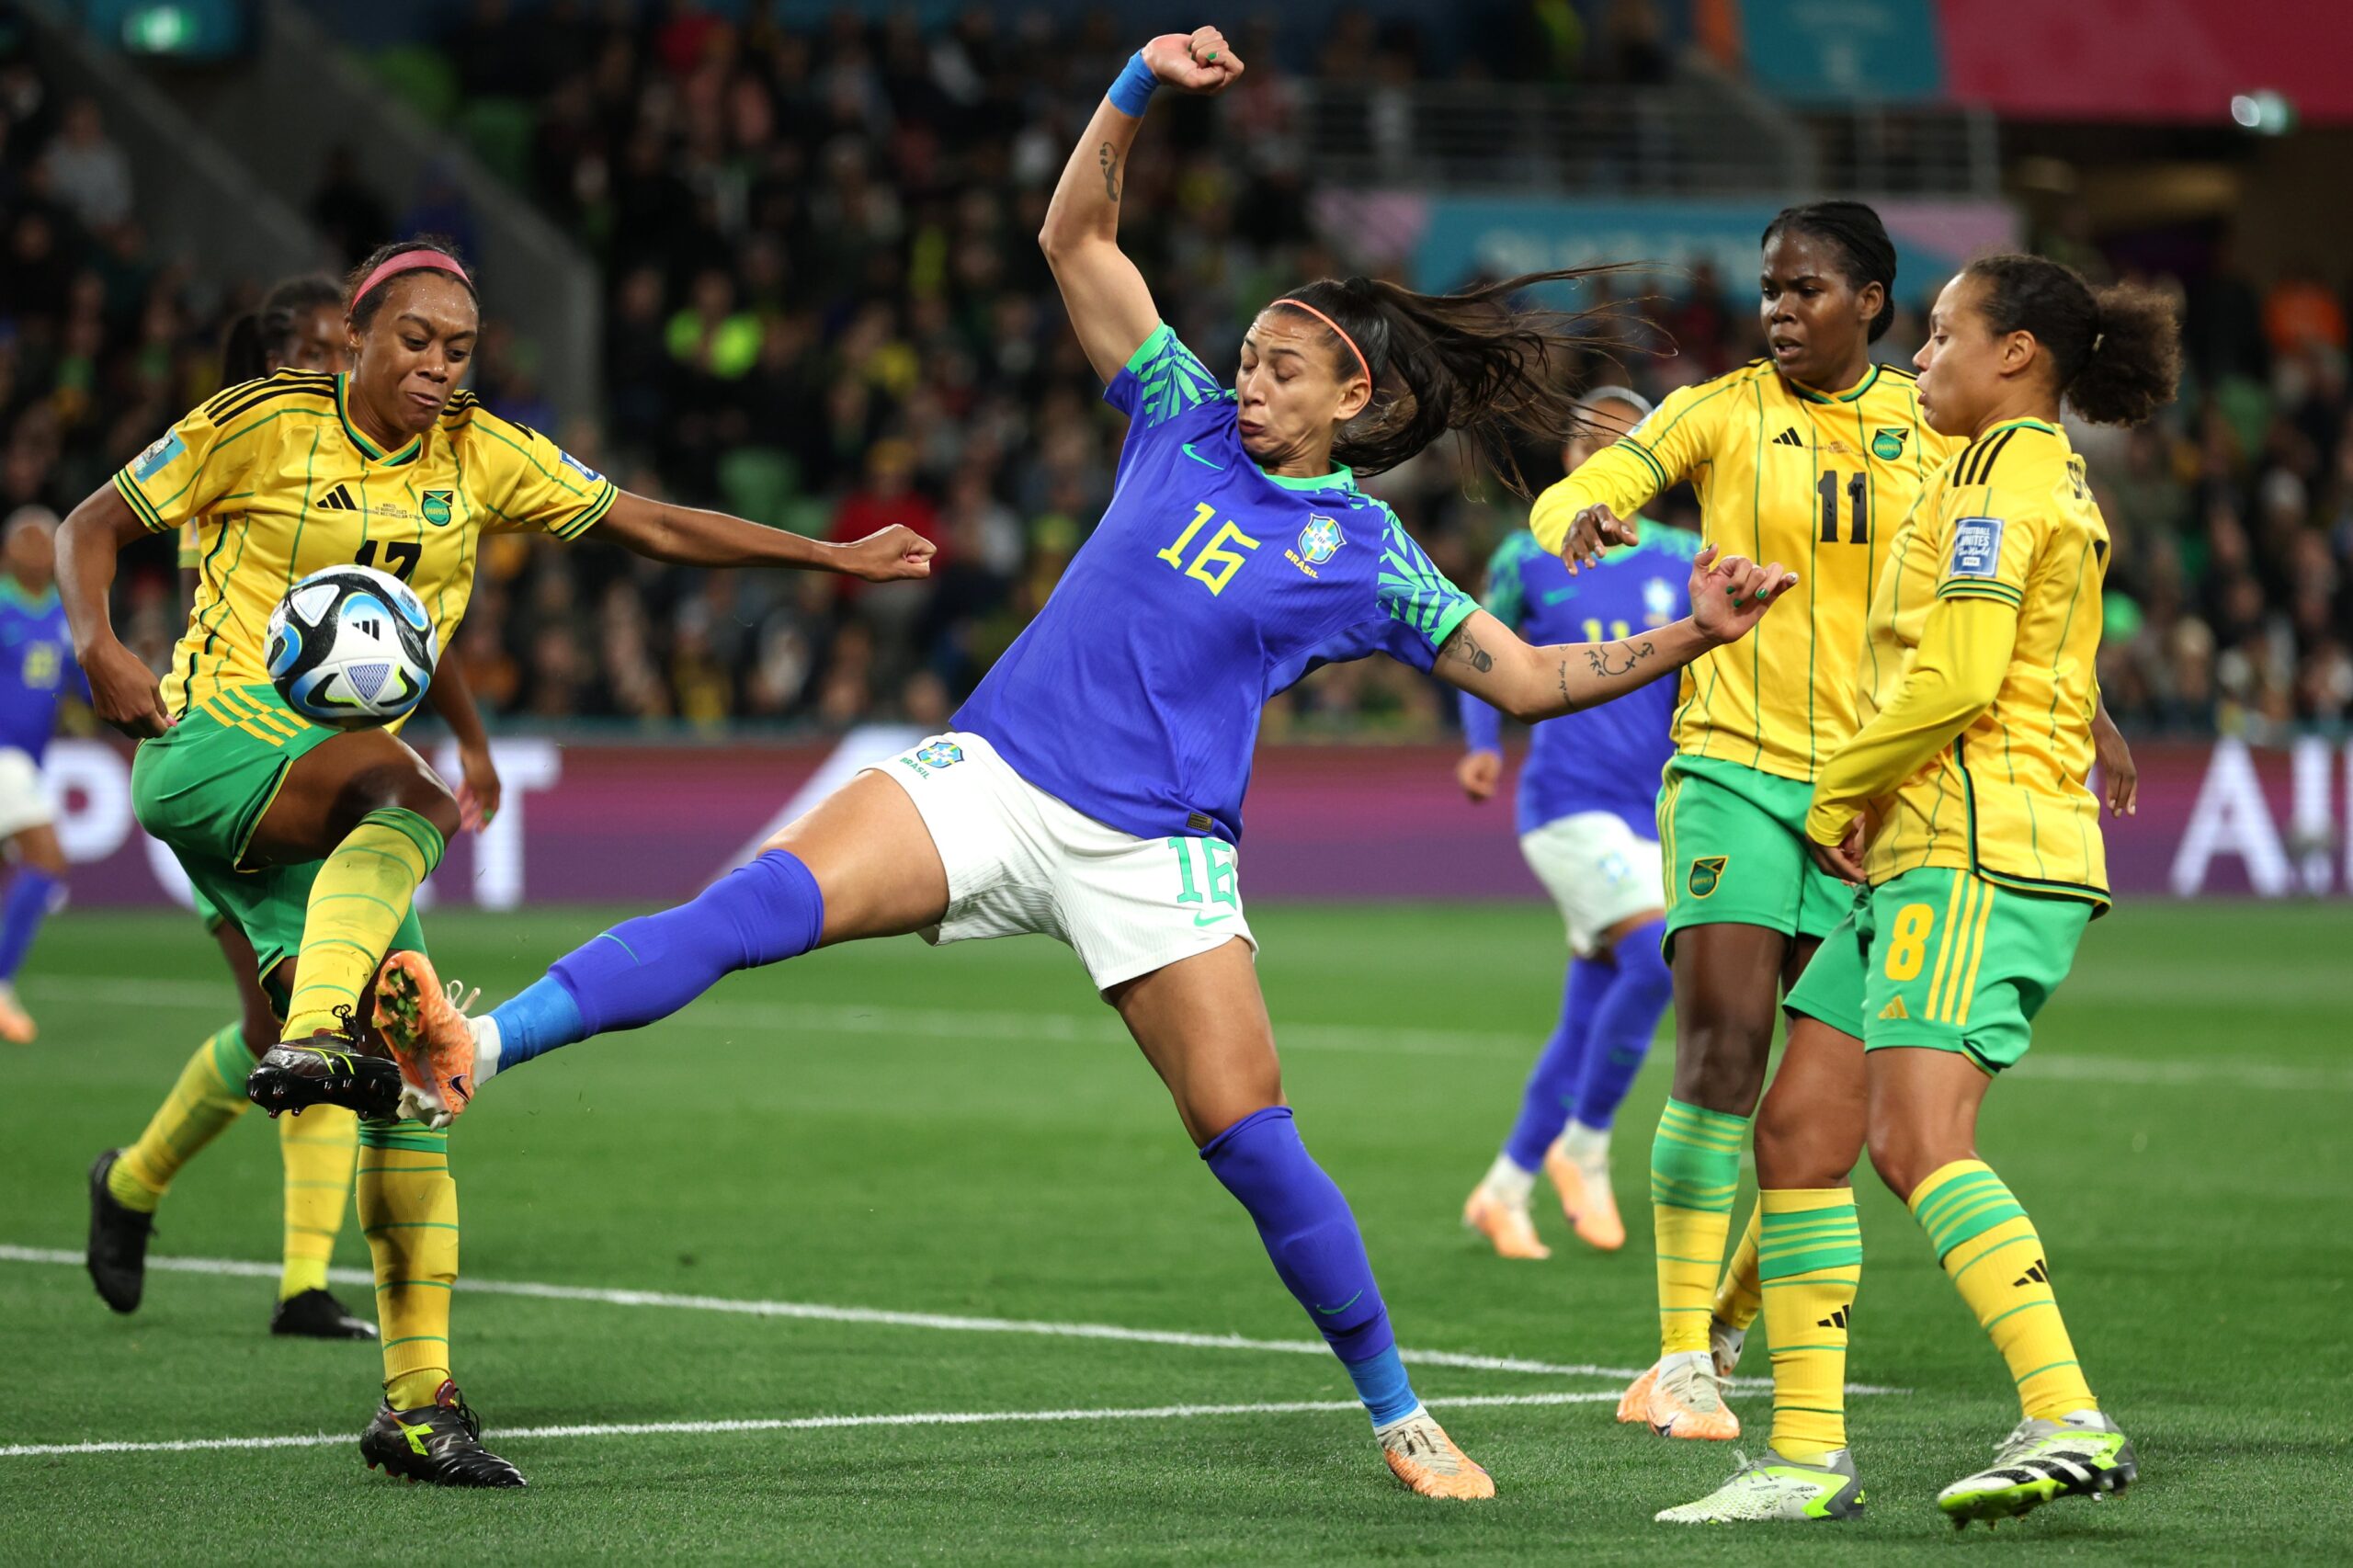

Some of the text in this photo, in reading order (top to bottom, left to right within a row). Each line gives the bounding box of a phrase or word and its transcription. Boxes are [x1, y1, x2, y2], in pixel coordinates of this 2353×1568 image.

[1818, 470, 1869, 544] 11
[1156, 501, 1262, 597] 16
[1284, 549, 1319, 579] BRASIL
[900, 756, 931, 779] BRASIL
[1167, 835, 1237, 911] 16
[1885, 903, 1934, 982] 8
